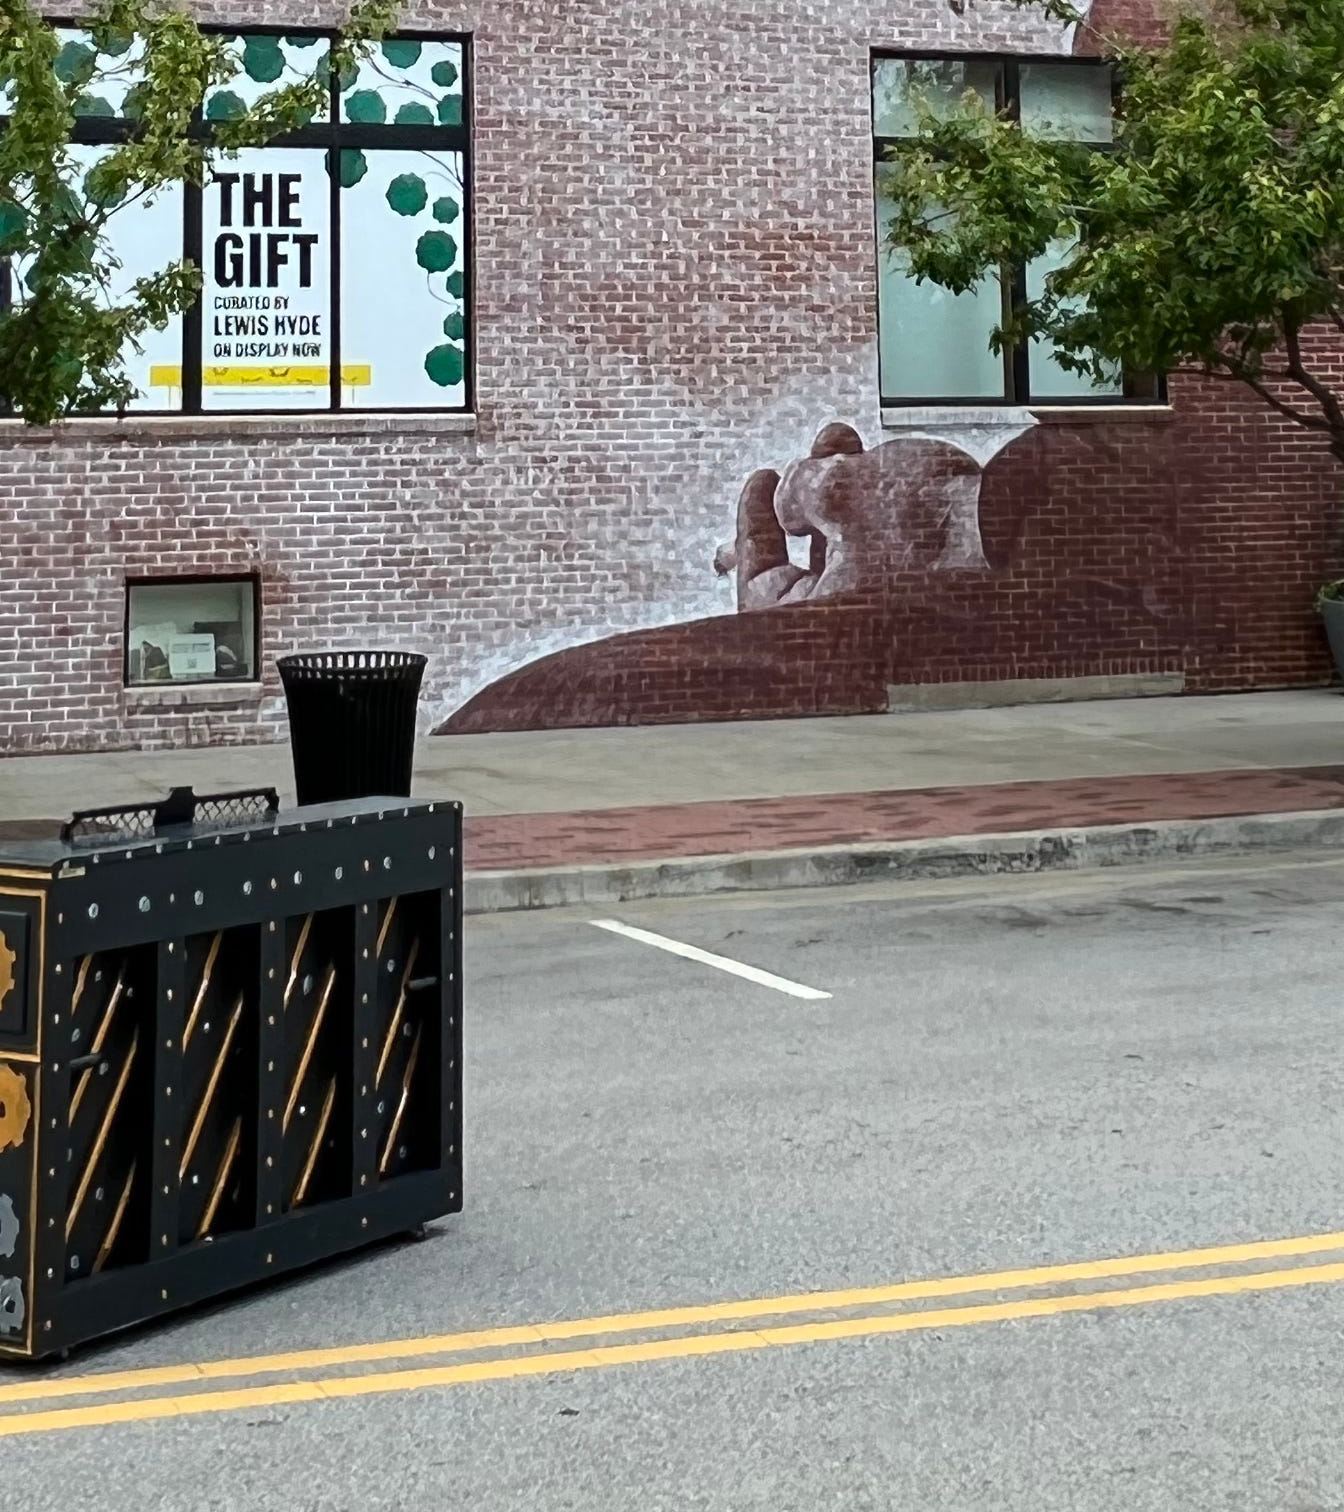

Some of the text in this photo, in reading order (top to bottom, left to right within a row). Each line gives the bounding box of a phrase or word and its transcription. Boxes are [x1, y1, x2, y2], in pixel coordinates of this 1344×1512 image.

[212, 172, 303, 228] THE
[214, 232, 319, 288] GIFT
[214, 295, 290, 310] CURATED BY
[214, 314, 321, 336] LEWIS HYDE
[214, 342, 322, 357] ON DISPLAY NOW
